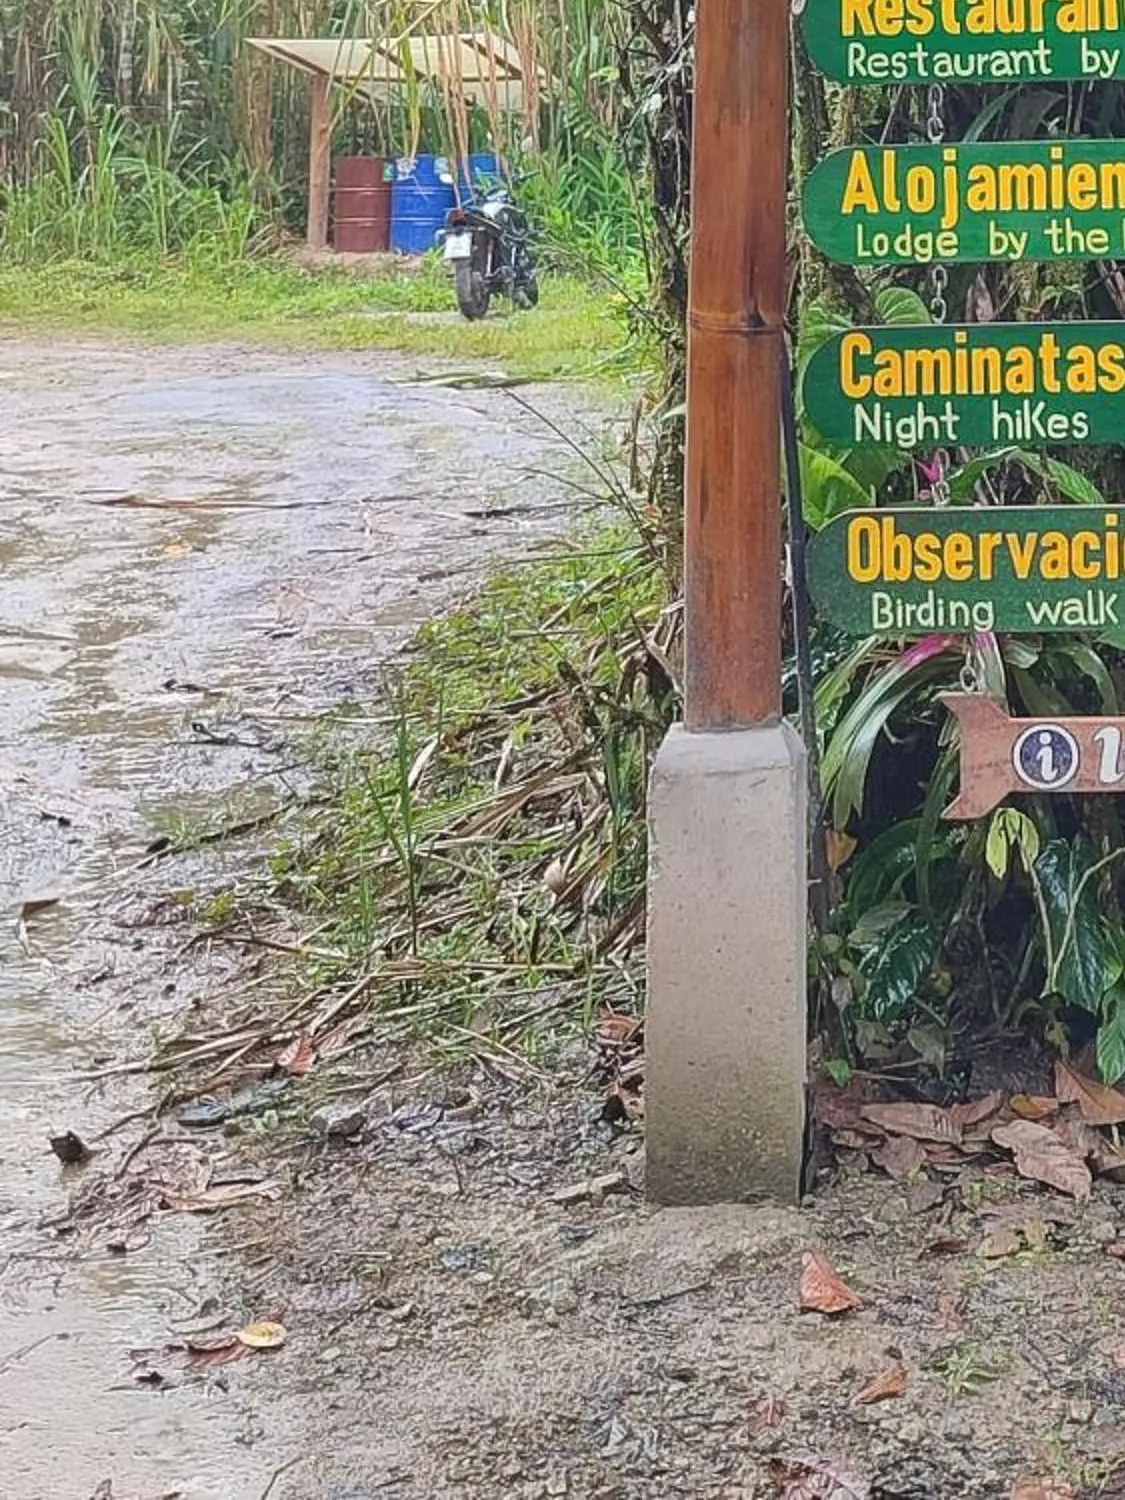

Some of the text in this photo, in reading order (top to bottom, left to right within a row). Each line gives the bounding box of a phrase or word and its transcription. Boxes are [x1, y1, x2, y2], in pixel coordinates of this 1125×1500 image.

[847, 43, 1052, 78] Restaurant
[1081, 41, 1120, 78] by
[856, 224, 958, 260] Lodge
[990, 224, 1027, 260] by
[1045, 222, 1109, 254] the
[854, 400, 959, 447] Night
[873, 592, 995, 630] Birding
